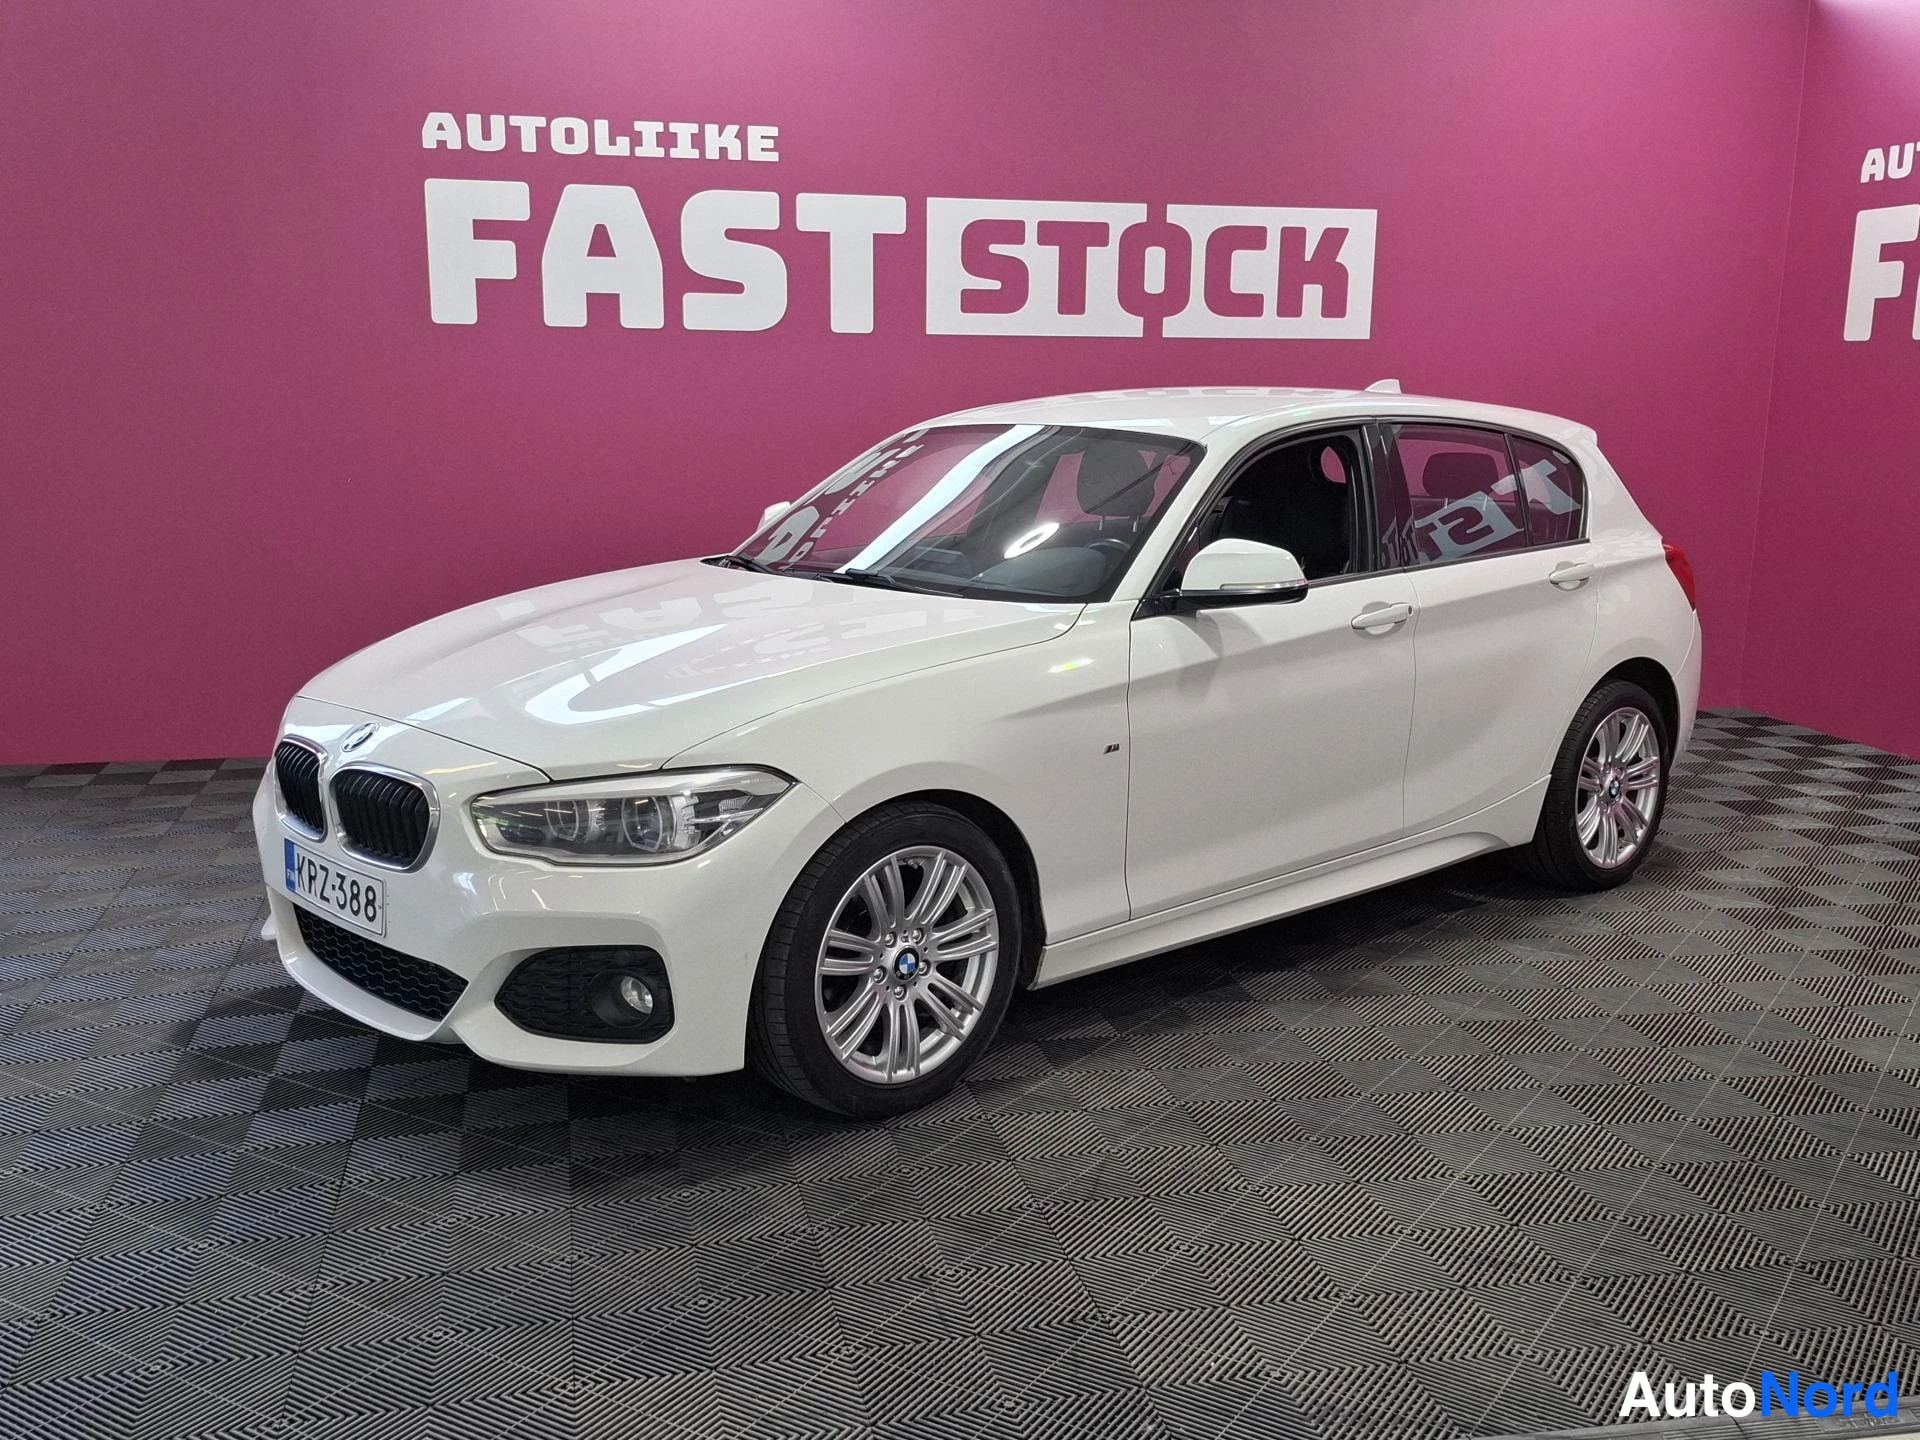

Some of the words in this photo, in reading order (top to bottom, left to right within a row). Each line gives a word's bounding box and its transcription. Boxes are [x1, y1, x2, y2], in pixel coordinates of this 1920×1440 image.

[421, 111, 780, 162] AUTOLIIKE
[1860, 141, 1920, 183] AU
[423, 177, 907, 334] FAST
[959, 217, 1350, 320] STOCK
[1843, 203, 1920, 342] F
[296, 851, 378, 923] KRZ-388
